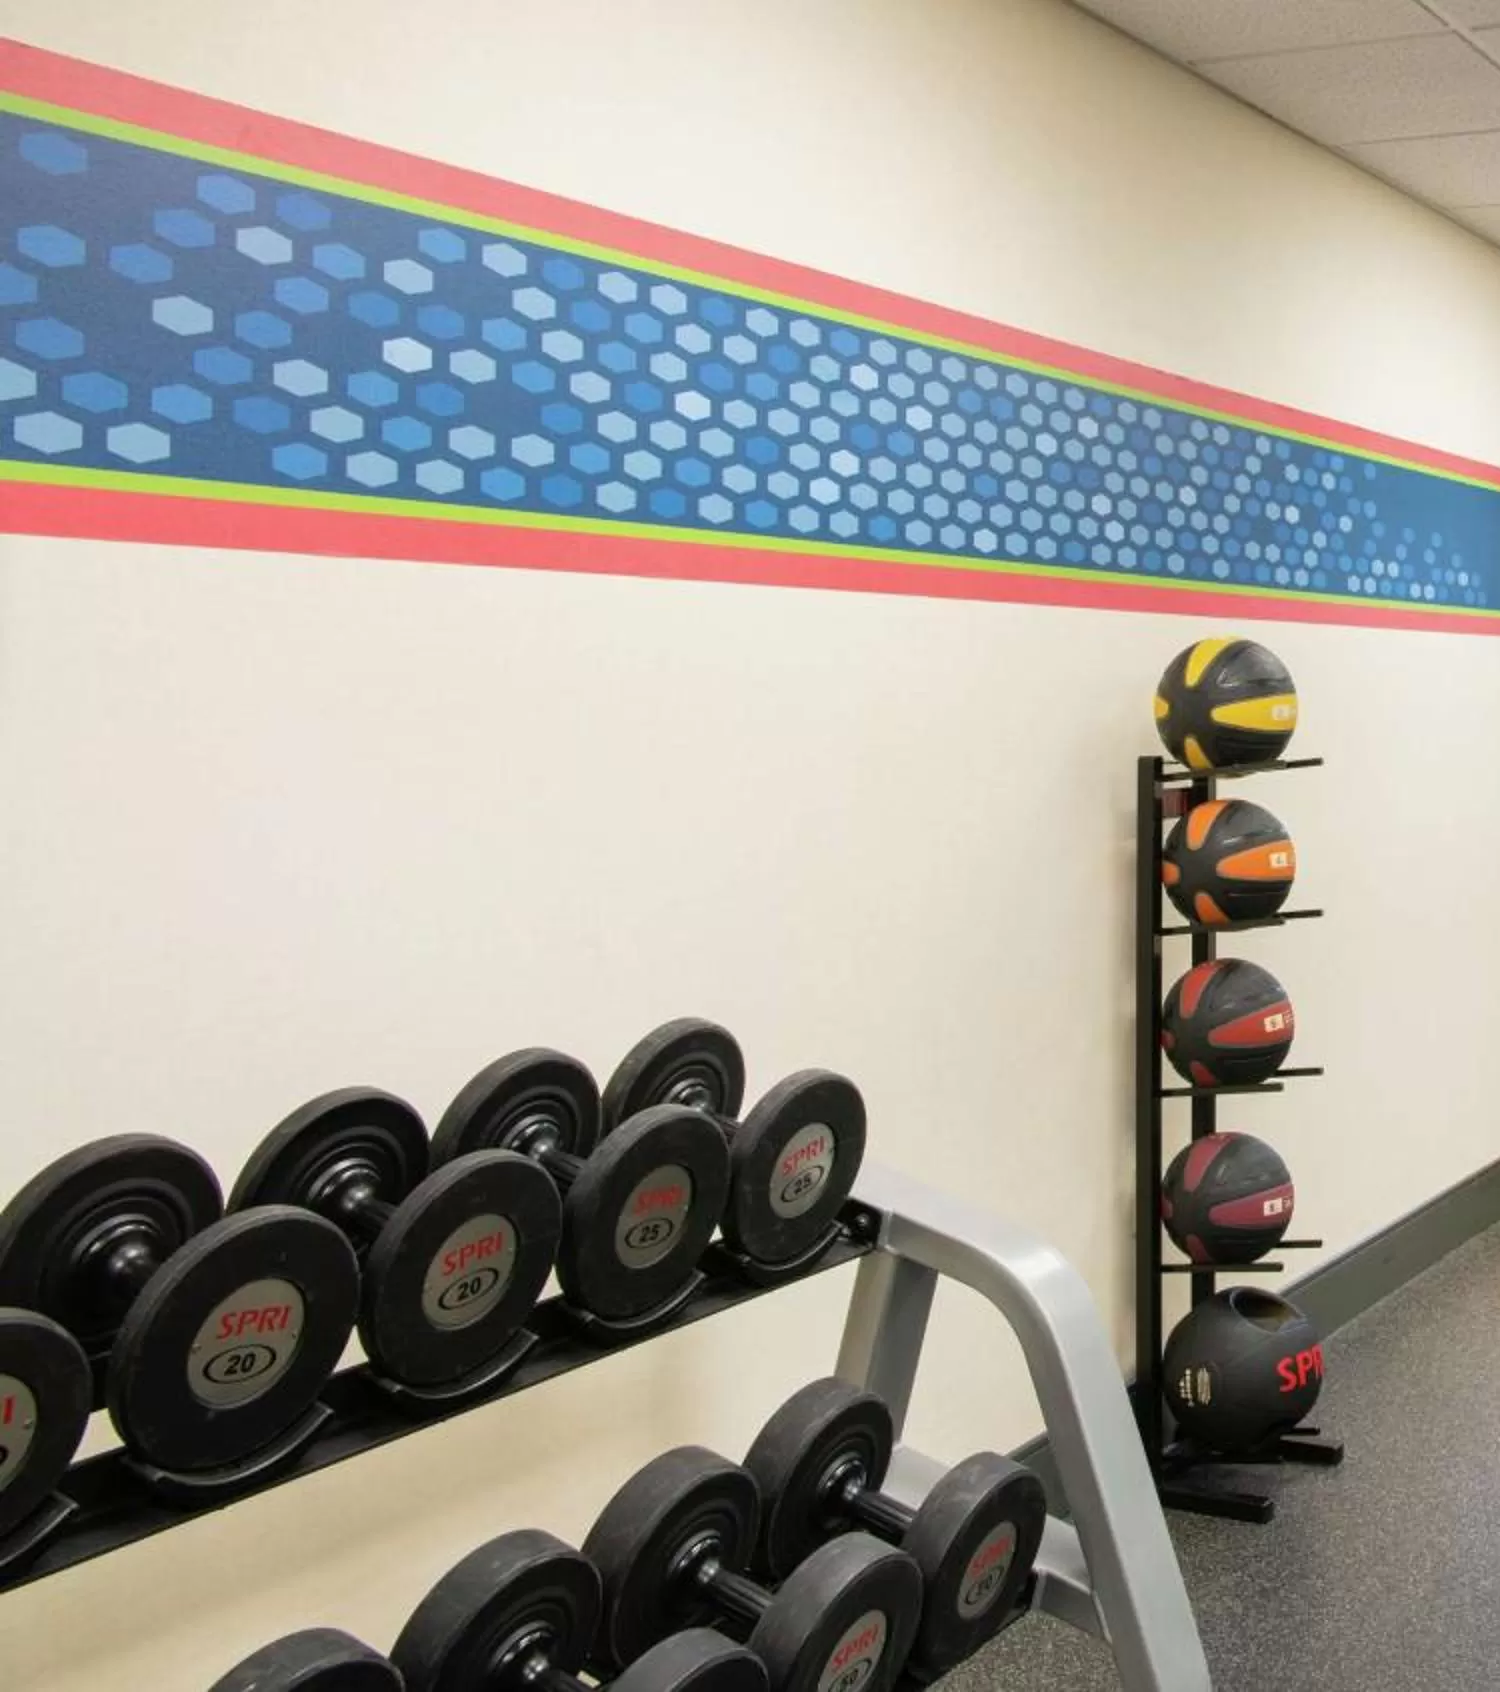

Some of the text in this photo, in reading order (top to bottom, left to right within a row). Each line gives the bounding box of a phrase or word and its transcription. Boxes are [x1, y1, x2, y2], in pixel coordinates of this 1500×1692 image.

[638, 1224, 660, 1244] 25
[441, 1231, 507, 1277] SPRI
[457, 1276, 482, 1301] 20
[215, 1304, 292, 1341] SPRI
[223, 1352, 256, 1377] 20
[1276, 1343, 1325, 1392] SPR
